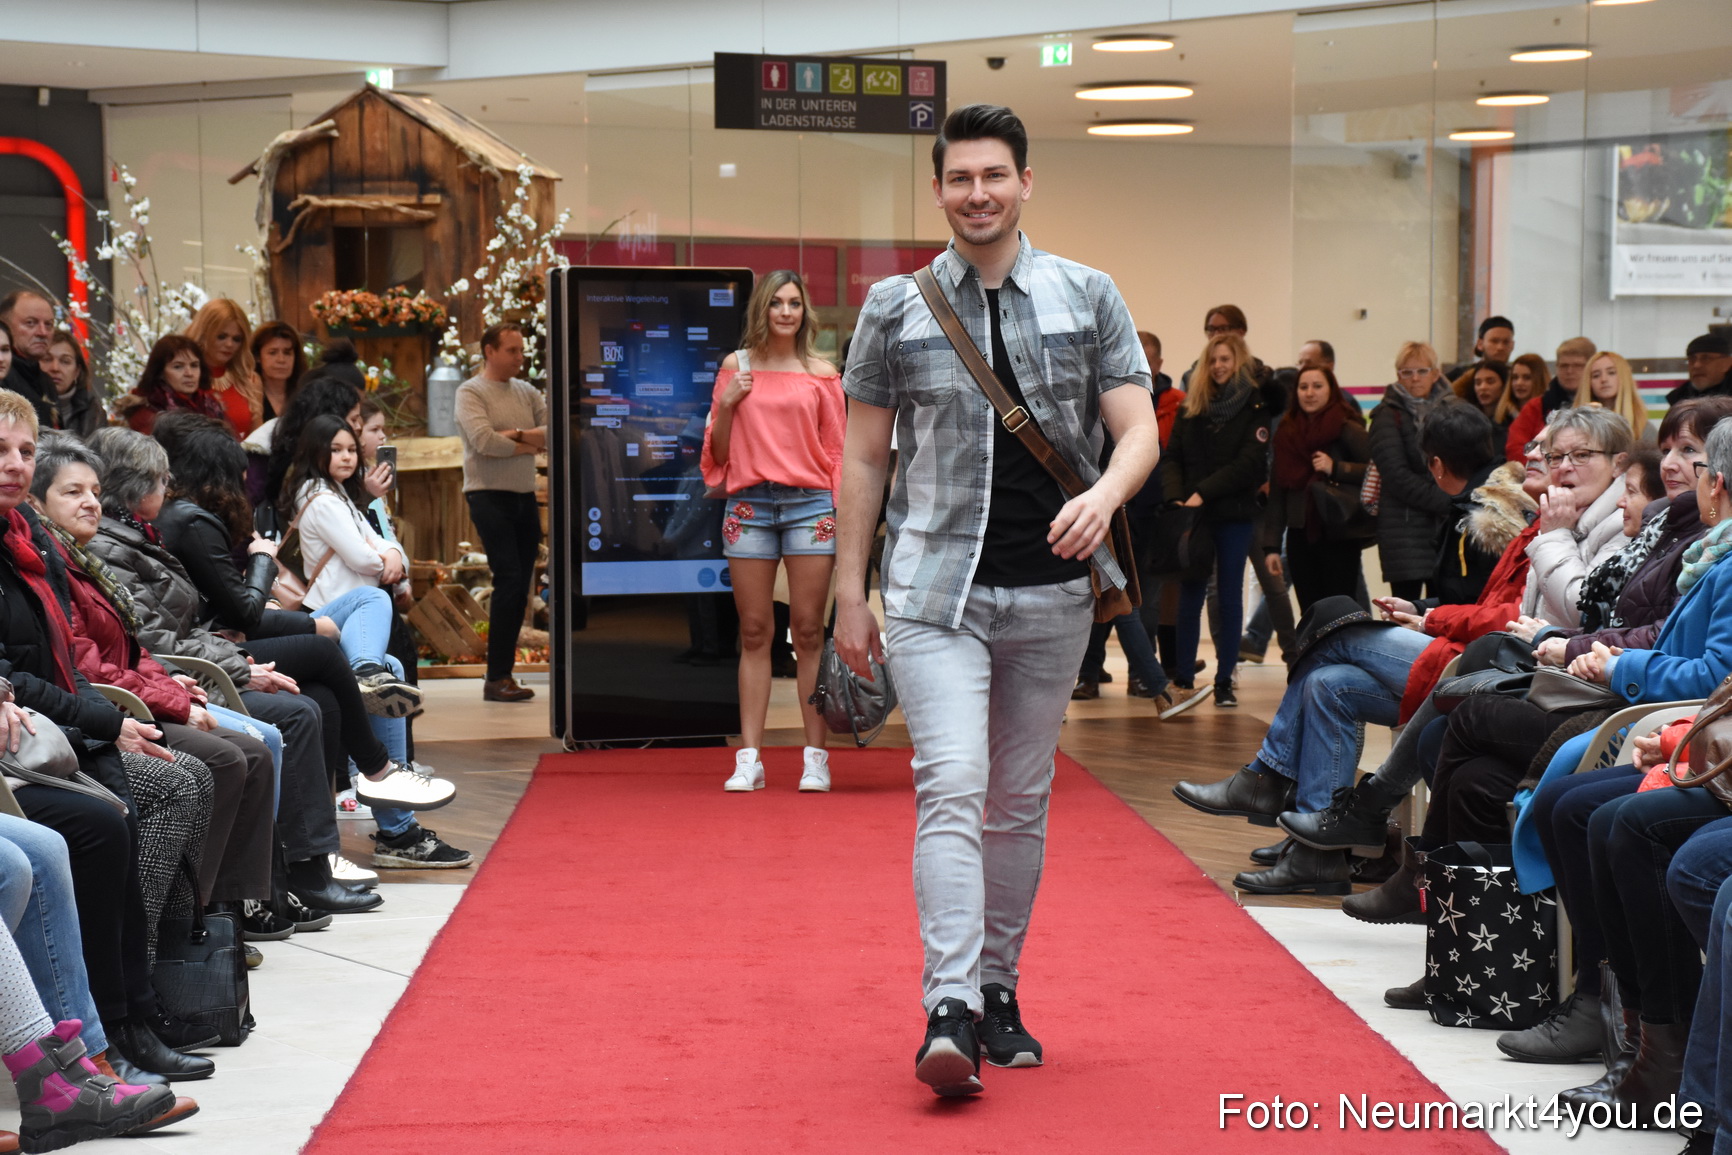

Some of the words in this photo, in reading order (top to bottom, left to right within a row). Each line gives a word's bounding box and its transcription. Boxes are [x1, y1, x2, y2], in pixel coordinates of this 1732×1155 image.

[761, 98, 772, 109] IN
[775, 98, 797, 110] DER
[801, 99, 857, 112] UNTEREN
[761, 114, 857, 129] LADENSTRASSE
[916, 111, 928, 128] P
[1647, 252, 1680, 263] freuen
[586, 294, 624, 303] Interaktive
[625, 294, 669, 304] Wegeleitung
